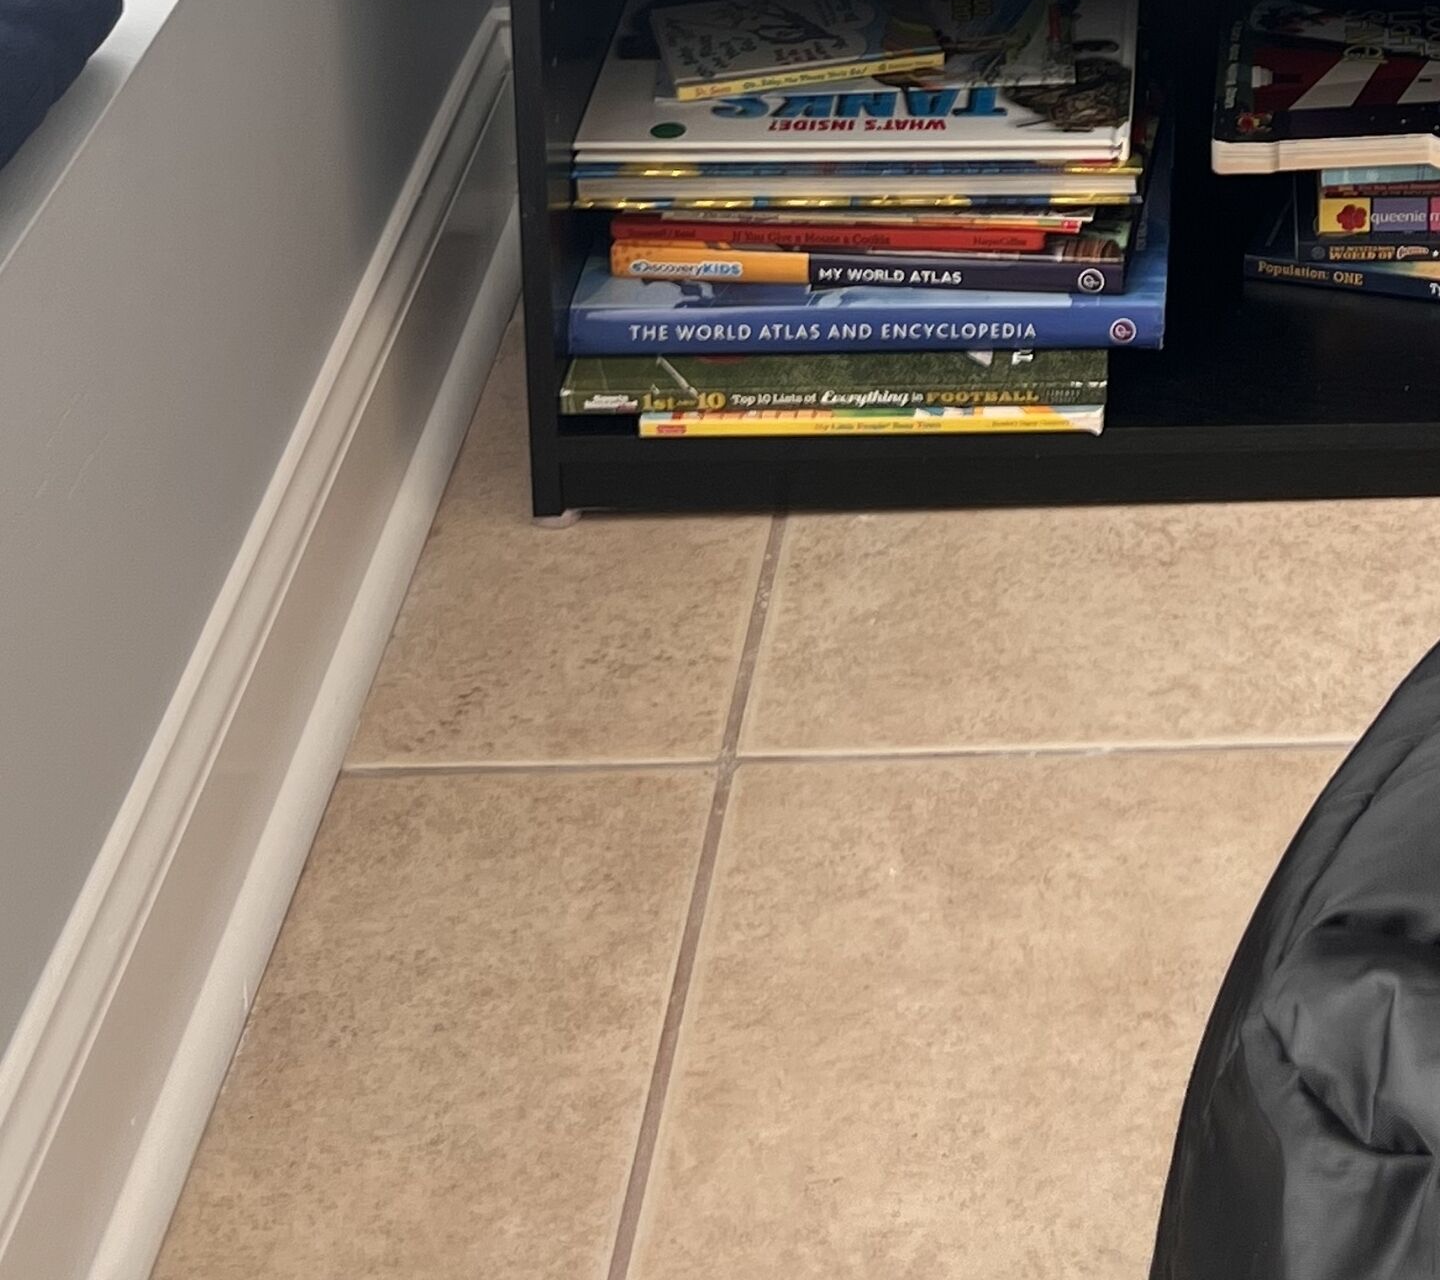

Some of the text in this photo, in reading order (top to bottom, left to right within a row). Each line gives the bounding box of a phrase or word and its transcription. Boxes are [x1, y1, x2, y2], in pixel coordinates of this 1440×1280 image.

[768, 119, 946, 132] WHAT'S INSIDE?
[1371, 209, 1427, 224] queenie
[818, 267, 962, 284] MY WORLD ATLAS
[1258, 260, 1364, 285] Population: ONE
[629, 323, 1037, 341] THE WORLD ATLAS AND ENCYCLOPEDIA
[642, 393, 674, 411] 1st
[698, 393, 726, 411] 10
[731, 394, 756, 406] Top
[758, 394, 771, 405] 10
[773, 394, 802, 404] Lists
[804, 393, 816, 403] of
[820, 390, 910, 407] Everything
[911, 392, 924, 402] in
[926, 390, 1040, 404] FOOTBALL
